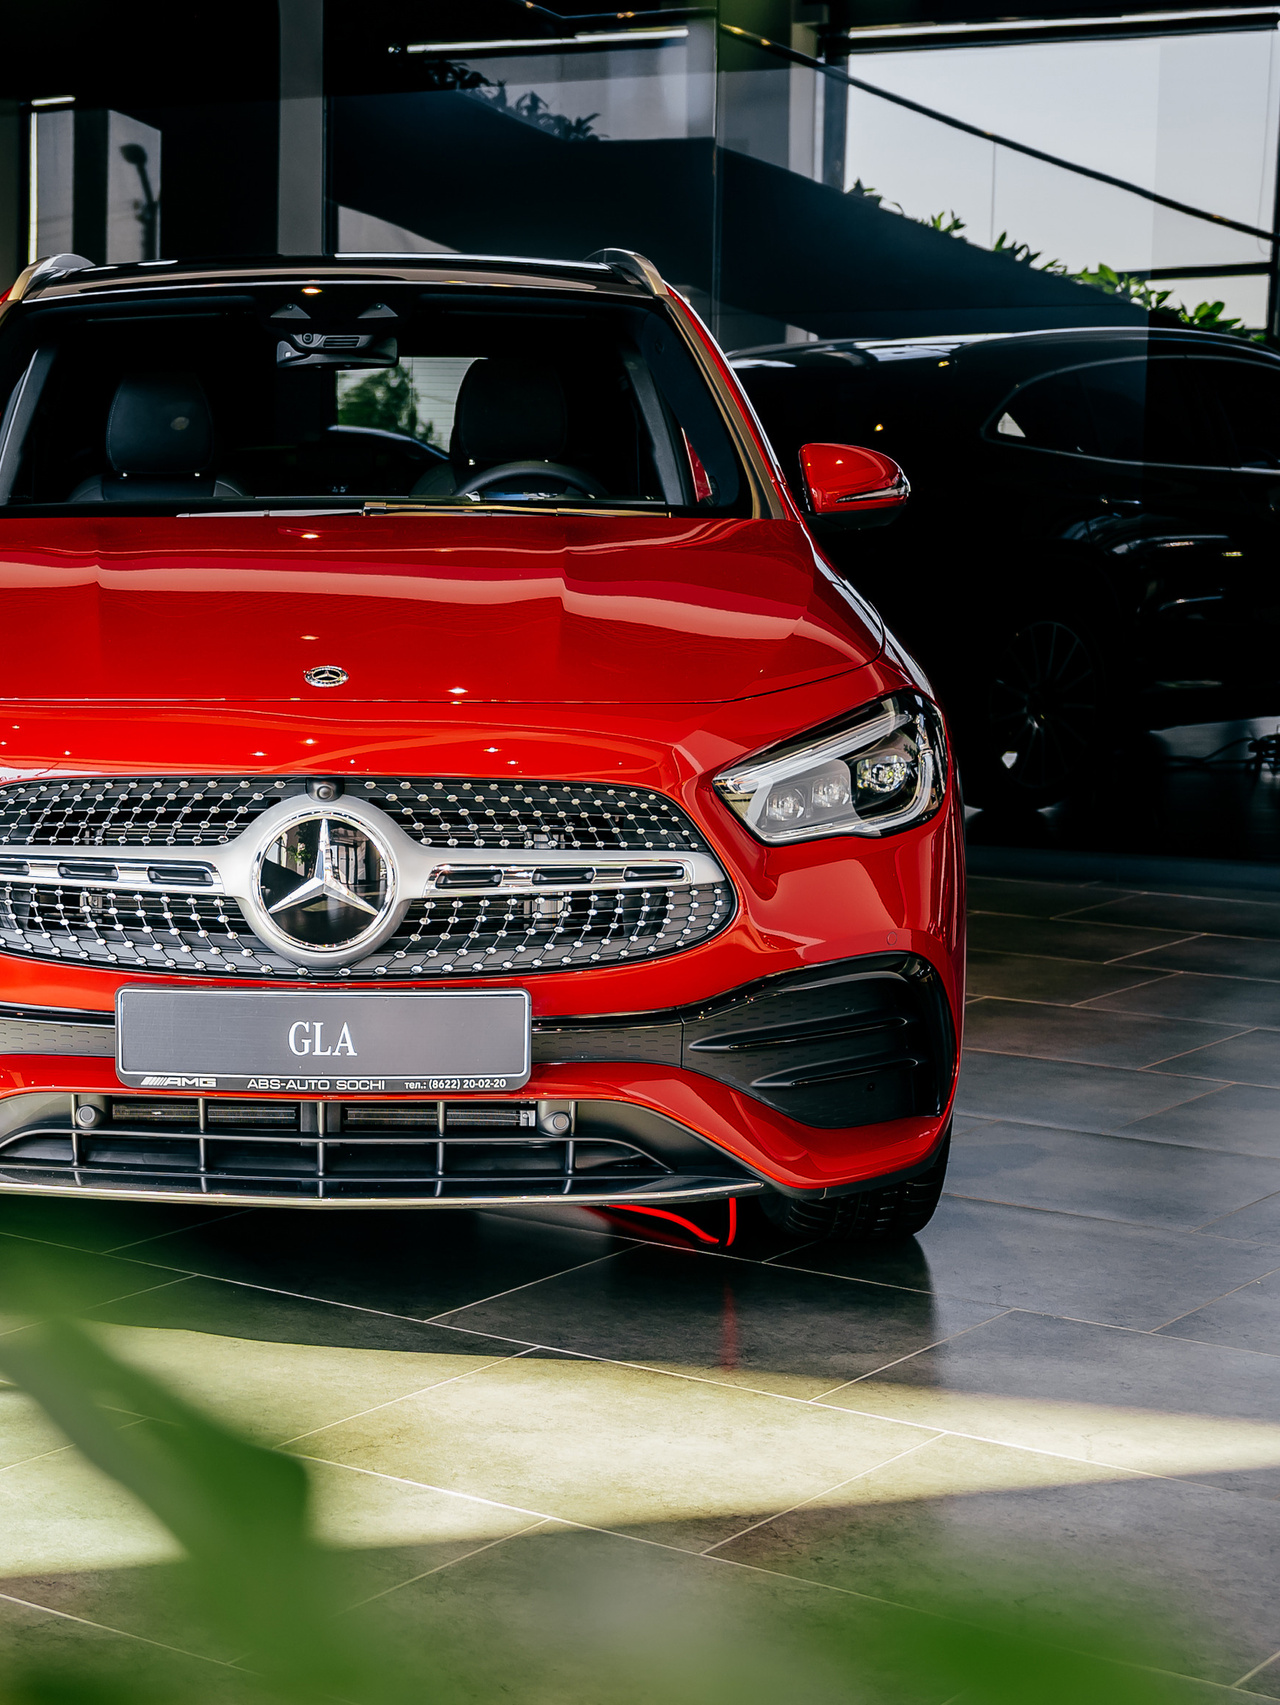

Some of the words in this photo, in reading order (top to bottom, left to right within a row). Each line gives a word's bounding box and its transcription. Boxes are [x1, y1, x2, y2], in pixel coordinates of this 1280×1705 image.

[288, 1021, 357, 1056] GLA
[163, 1076, 217, 1088] AMG
[247, 1078, 331, 1090] ABS-AUTO
[336, 1079, 385, 1091] SOCHI
[404, 1080, 427, 1090] тел.:
[428, 1078, 460, 1090] (8622)
[463, 1078, 507, 1089] 20-02-20
